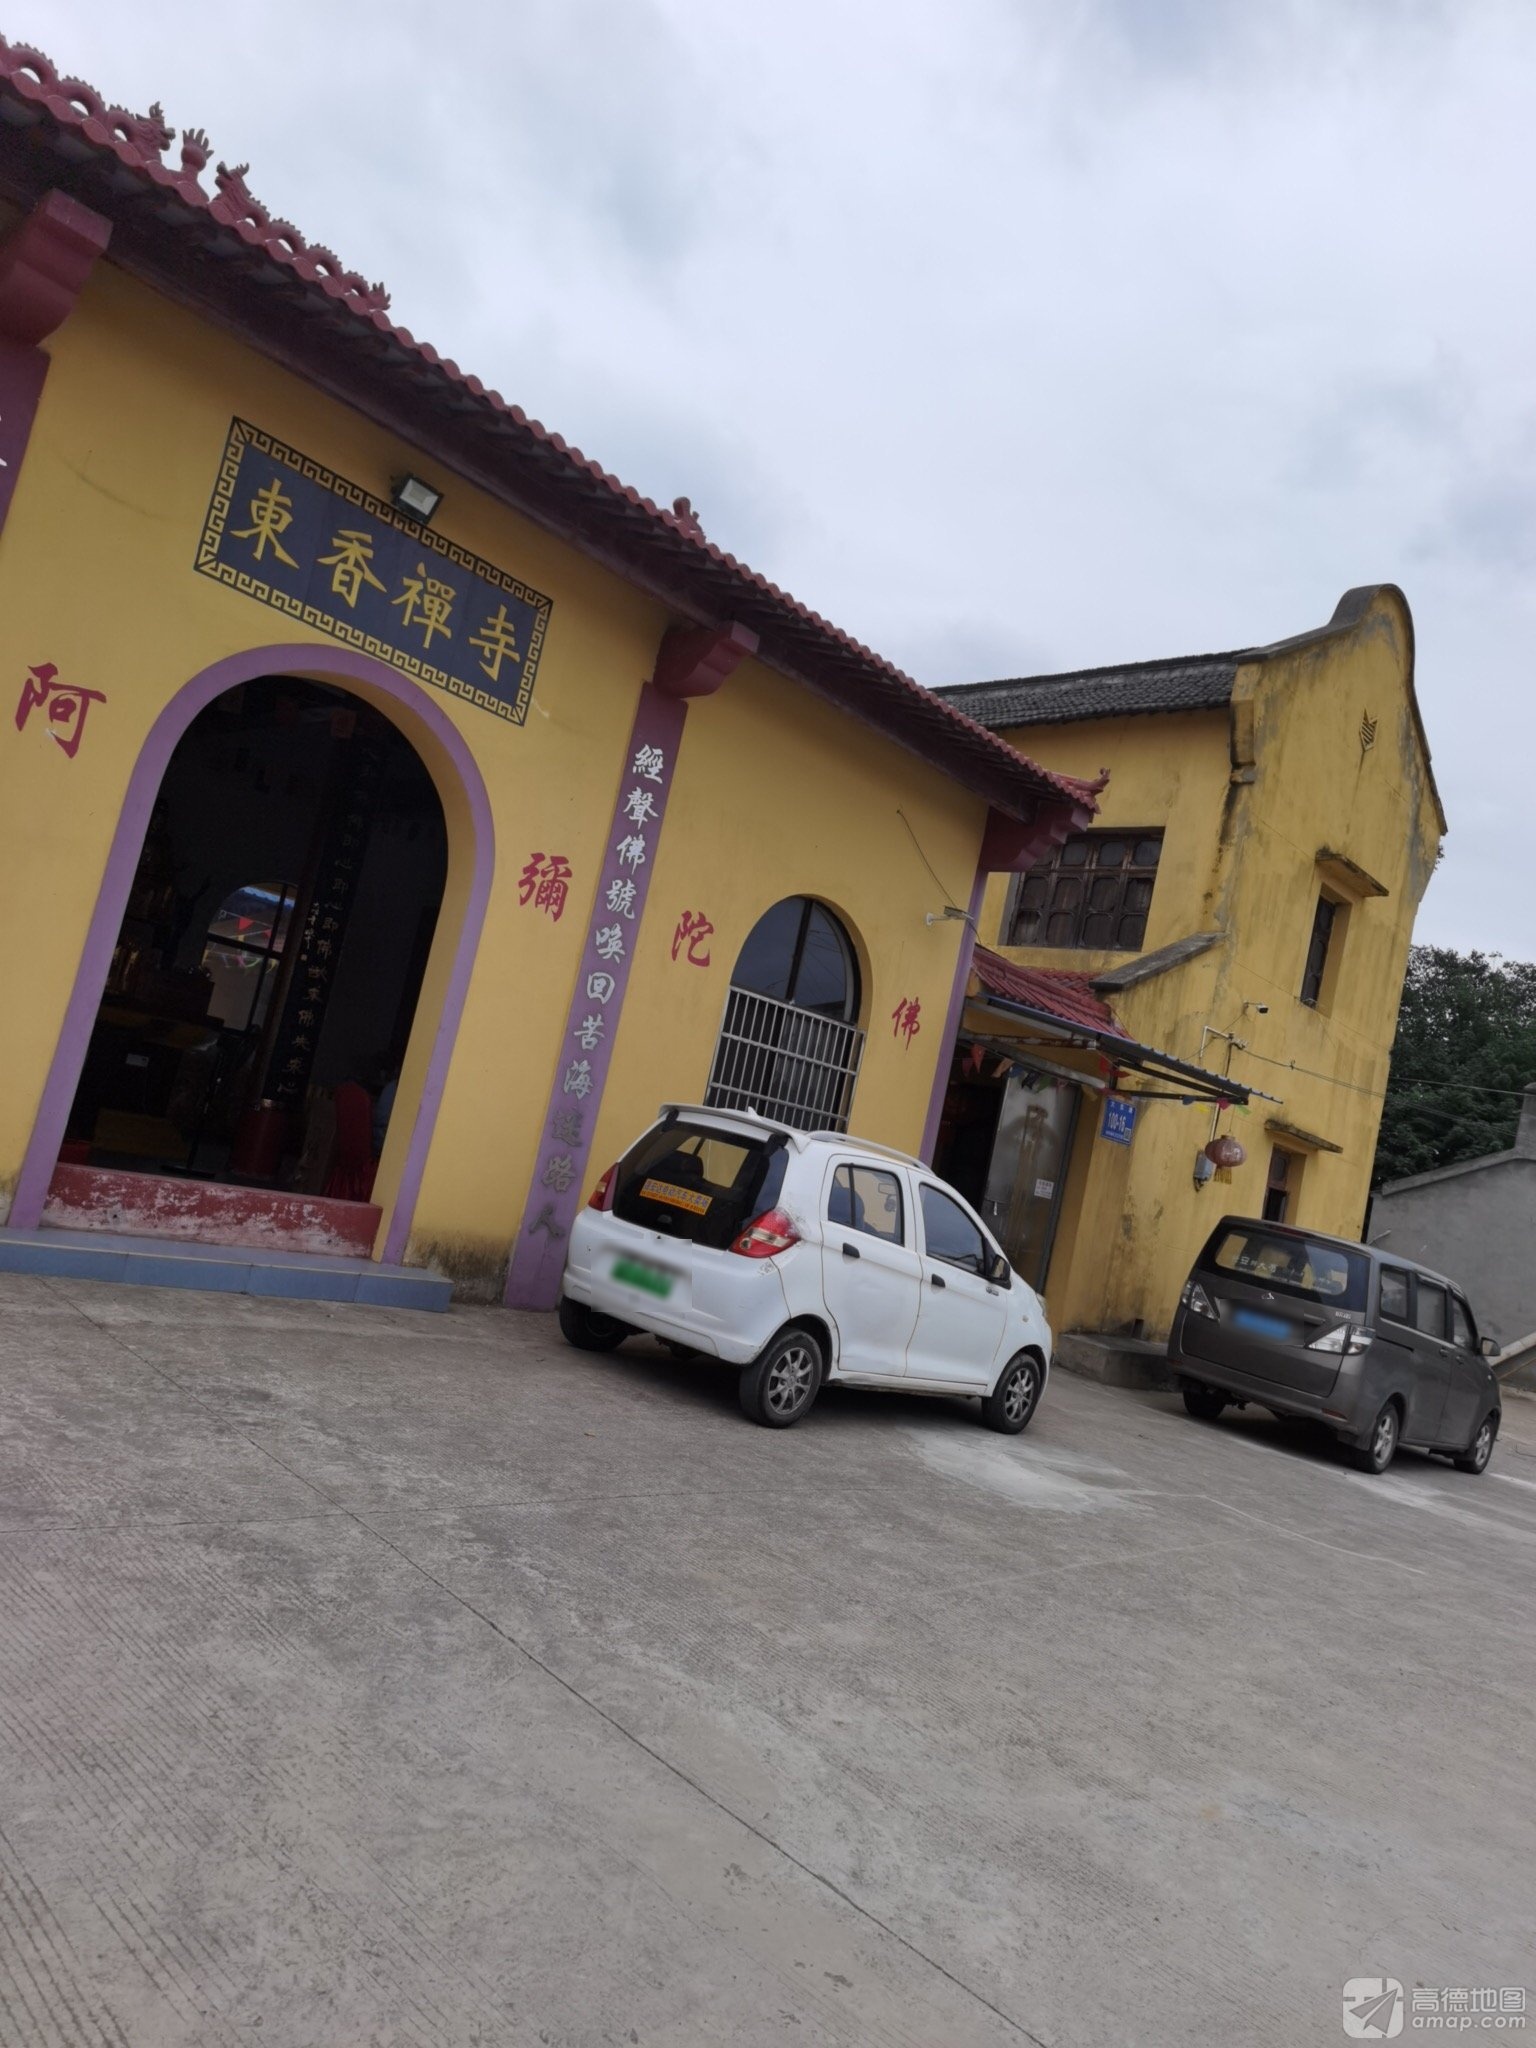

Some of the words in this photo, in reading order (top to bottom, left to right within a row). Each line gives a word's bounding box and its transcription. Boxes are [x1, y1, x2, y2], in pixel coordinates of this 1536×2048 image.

[230, 478, 522, 682] 東香禪寺
[14, 662, 107, 759] 阿
[517, 852, 574, 922] 彌
[670, 910, 715, 968] 陀
[891, 996, 922, 1051] 佛
